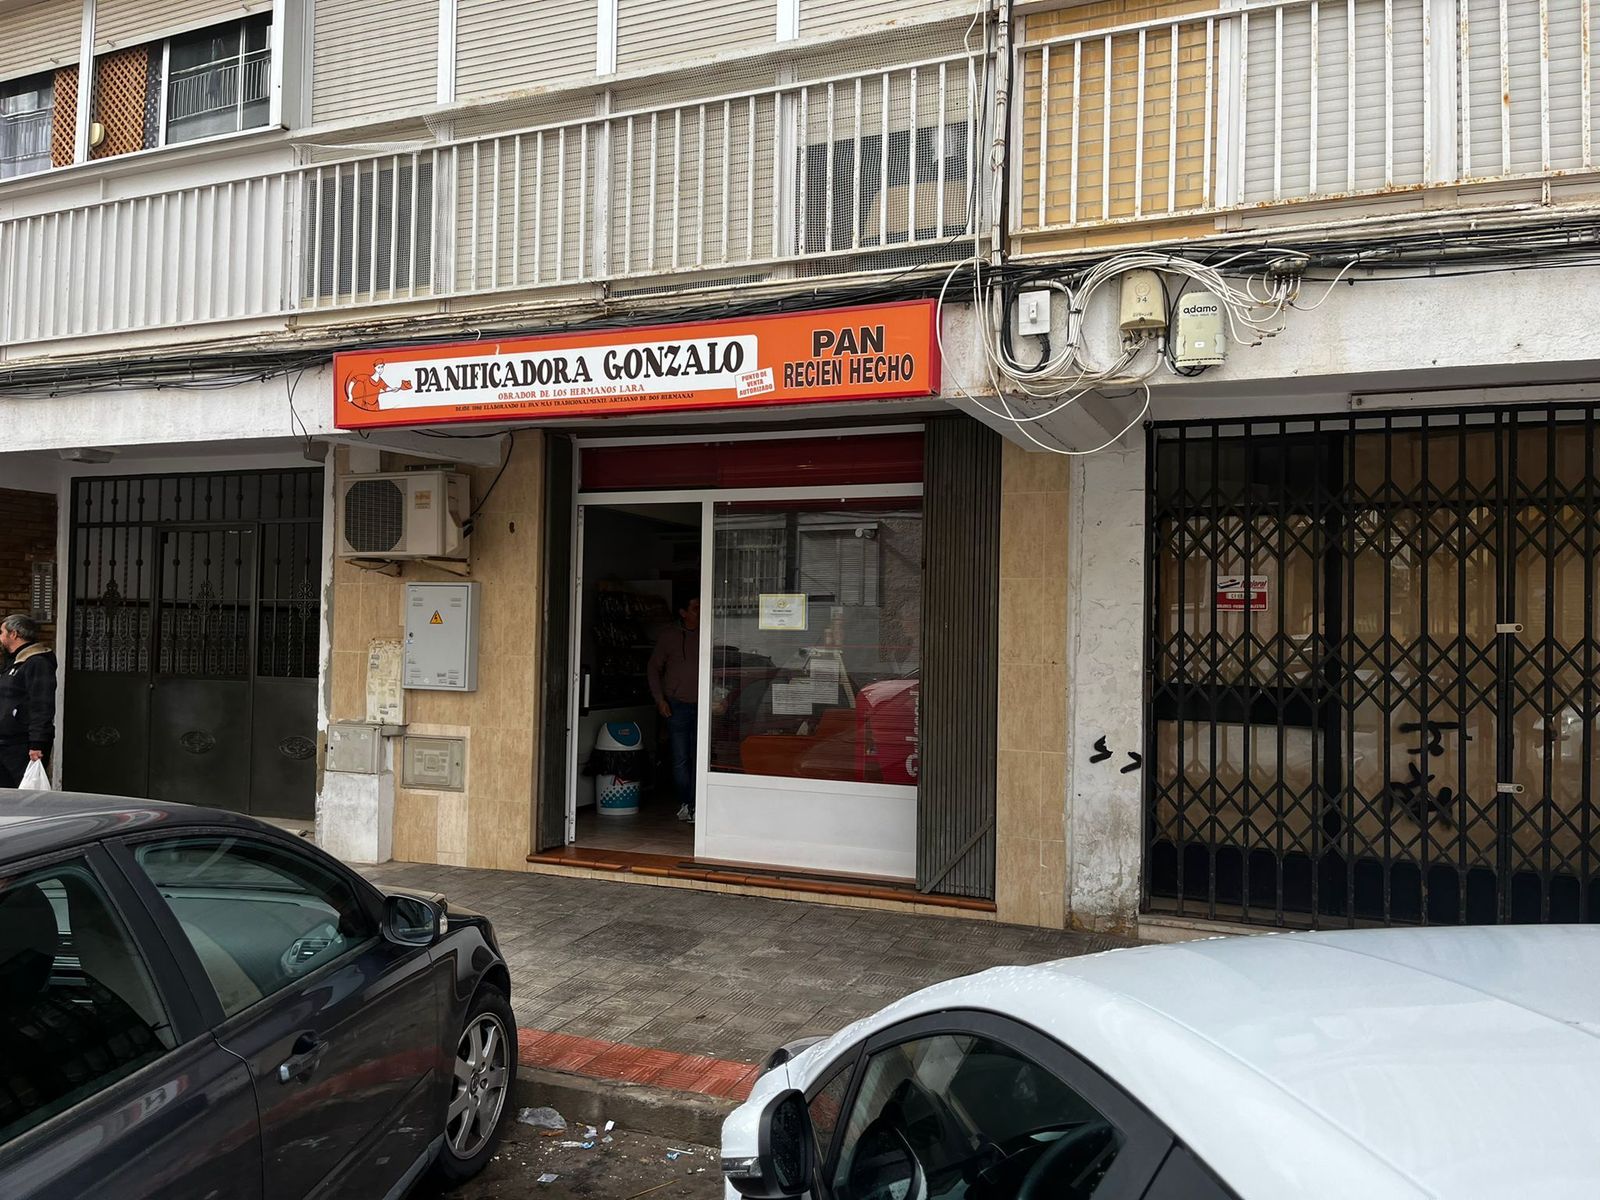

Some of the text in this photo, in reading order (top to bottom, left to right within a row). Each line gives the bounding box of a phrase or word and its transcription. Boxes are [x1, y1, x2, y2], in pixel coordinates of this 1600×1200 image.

[1183, 305, 1218, 314] adamo
[813, 326, 884, 357] PAN
[415, 341, 744, 393] PANIFICADORA GONZALO
[784, 353, 914, 388] RECIEN HECHO
[742, 372, 759, 382] PUNTO
[747, 379, 763, 387] VENTA
[498, 384, 645, 400] OBRADOR DE LOS HERMANOS LARA
[739, 384, 773, 396] AUTORIZADO
